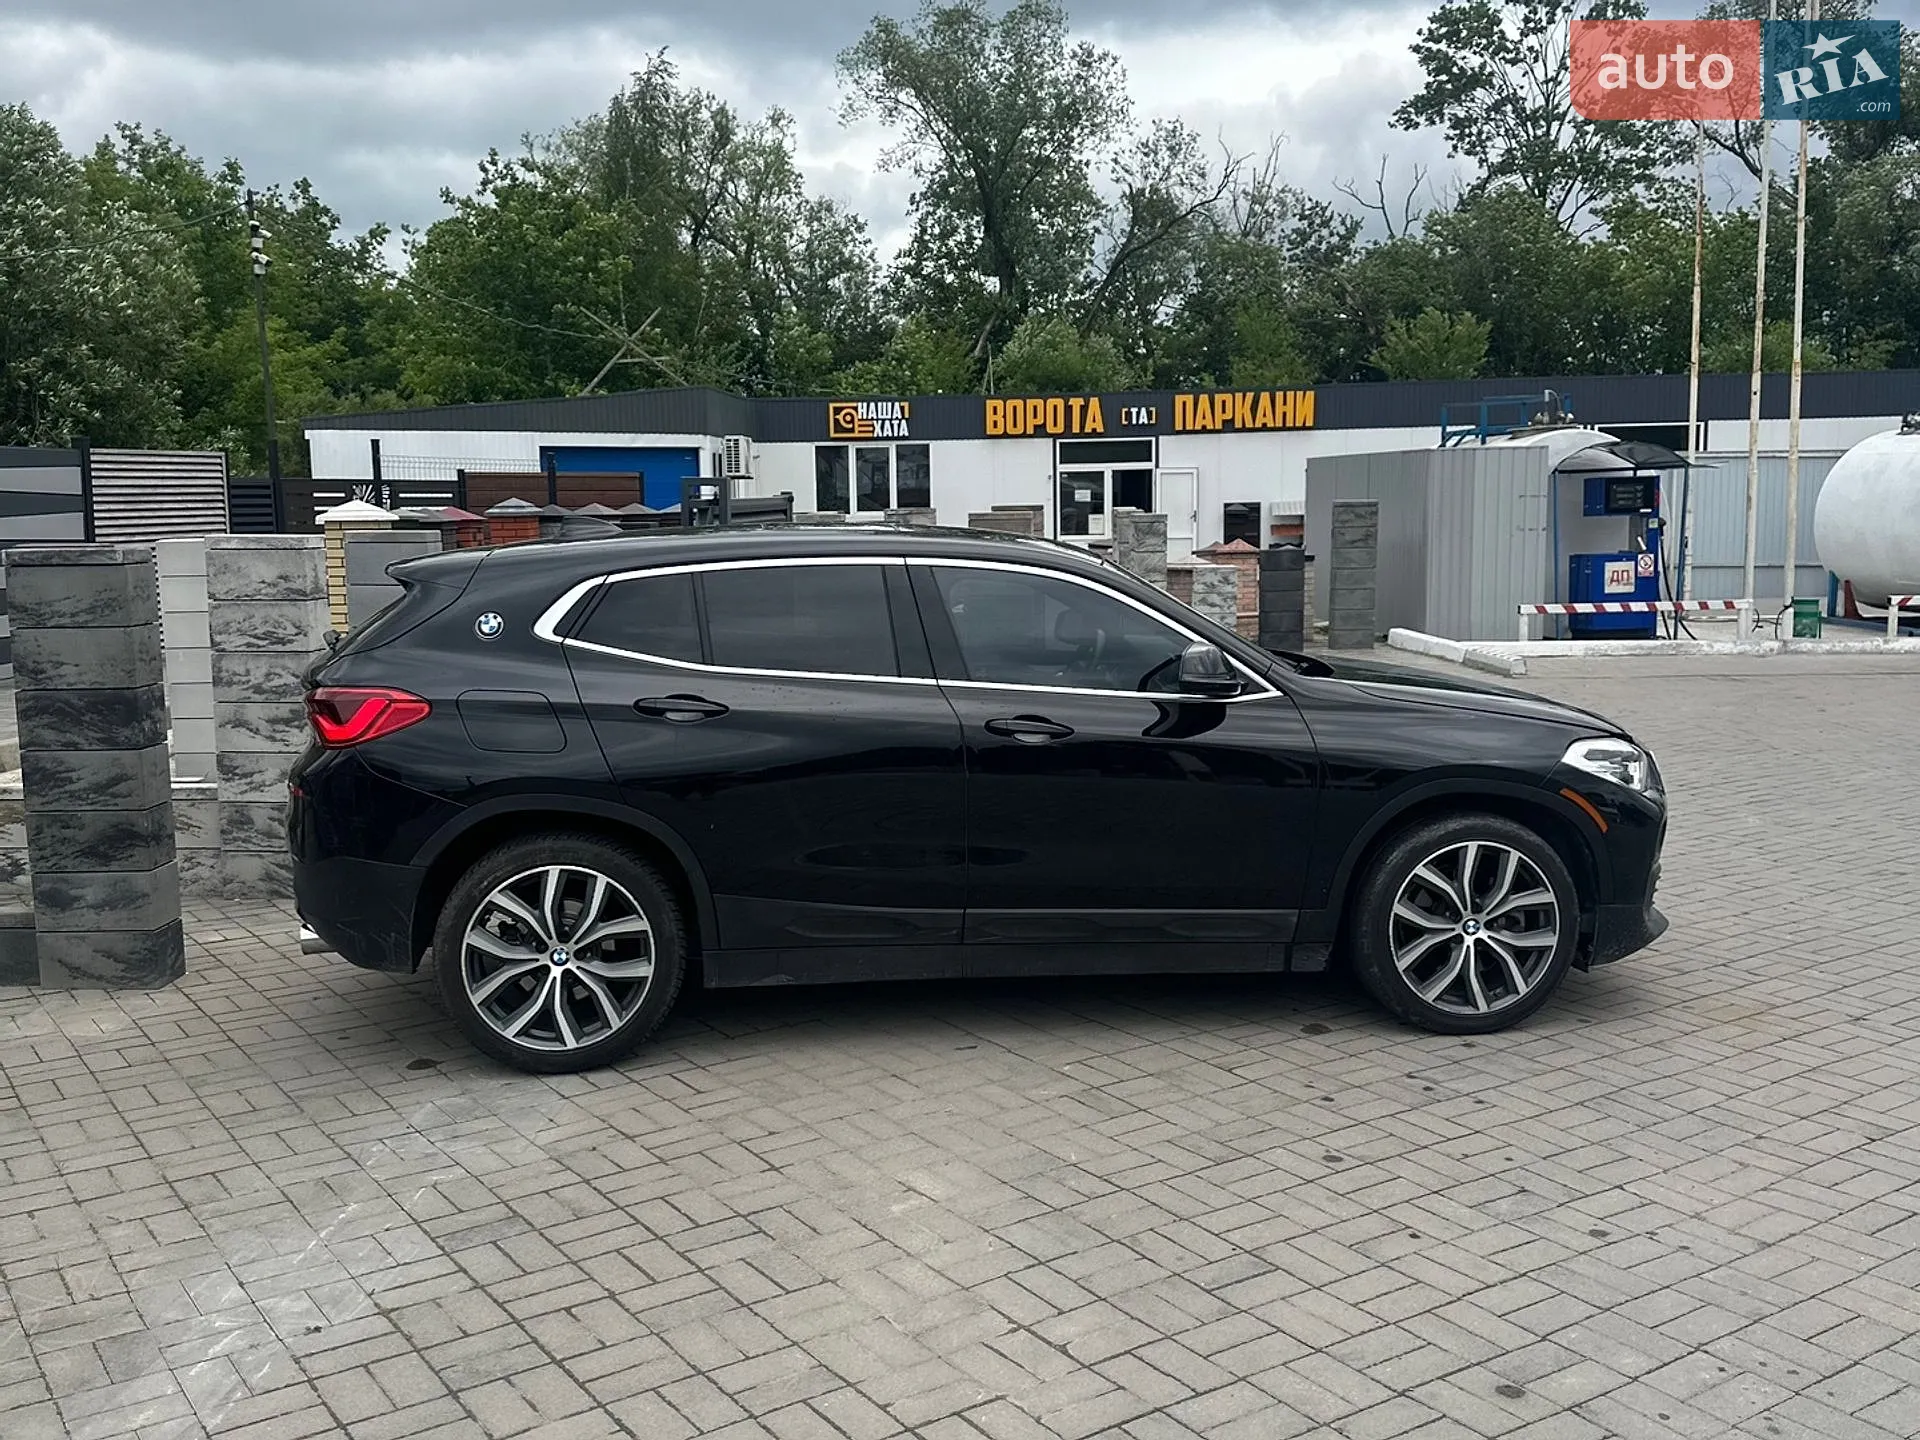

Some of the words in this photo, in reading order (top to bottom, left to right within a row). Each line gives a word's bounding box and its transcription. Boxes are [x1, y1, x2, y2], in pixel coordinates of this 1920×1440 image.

[857, 401, 902, 419] НАША
[985, 397, 1104, 435] ВОРОТА
[1174, 391, 1315, 431] ПАРКАНИ
[873, 419, 909, 437] ХАТА
[1610, 569, 1630, 585] ДП
